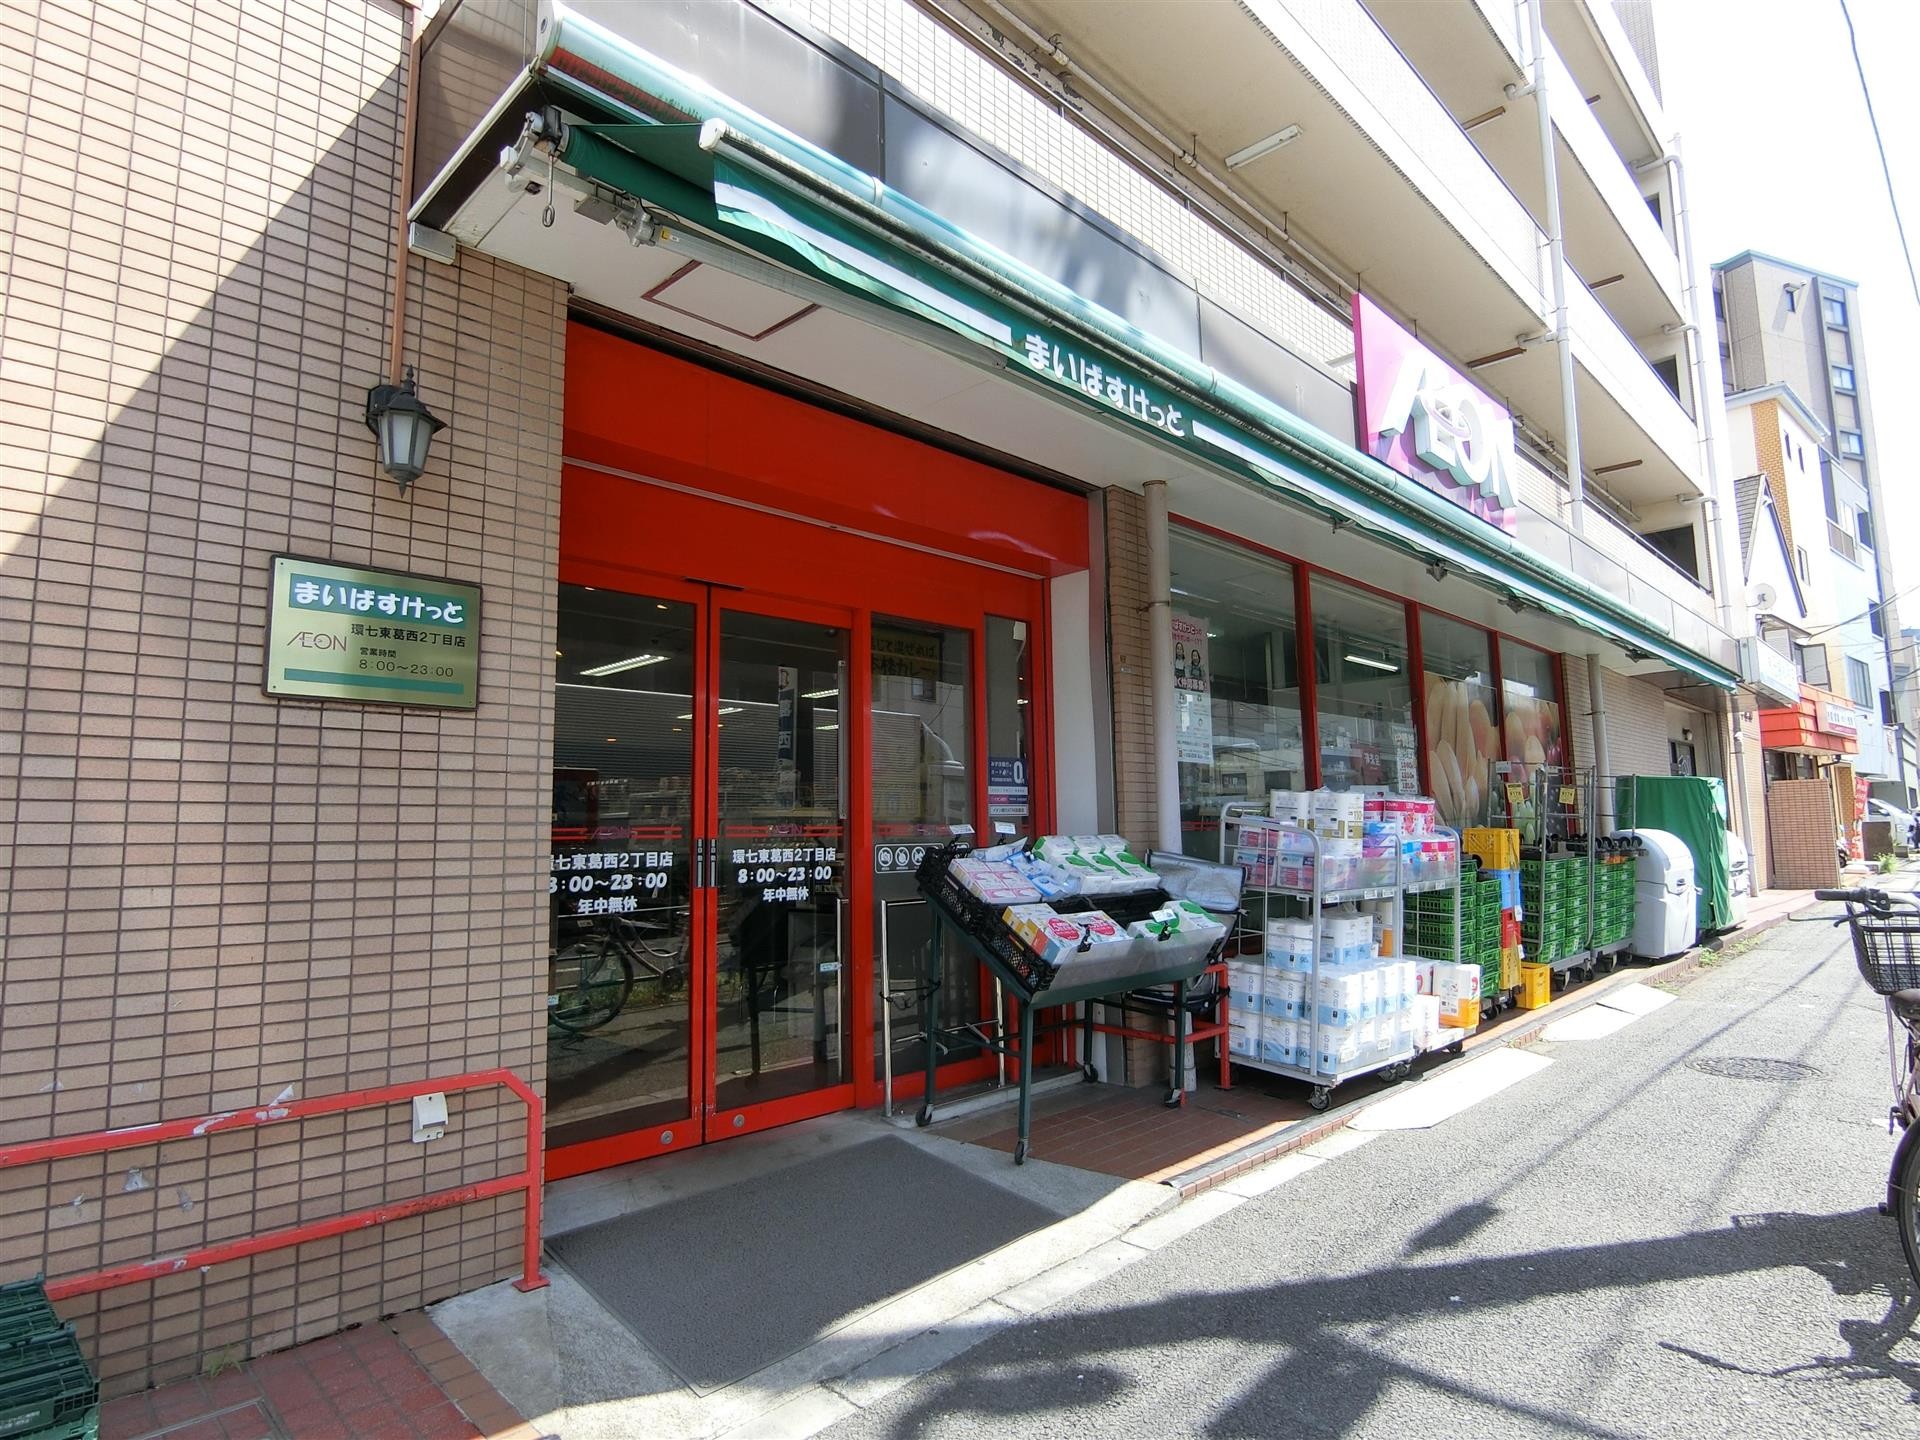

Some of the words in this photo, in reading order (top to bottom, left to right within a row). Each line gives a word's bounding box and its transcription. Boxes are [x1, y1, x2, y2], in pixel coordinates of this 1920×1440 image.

[1024, 334, 1185, 437] まいばすけっと
[294, 581, 464, 624] まいばすけっと
[350, 623, 467, 648] 環七東葛西2丁目店
[359, 646, 397, 659] 営業時間
[550, 851, 674, 870] 七東葛西2丁目店
[732, 847, 836, 864] 環七東葛西2丁目店
[763, 886, 810, 902] 年中無休
[577, 895, 638, 914] 年中無休
